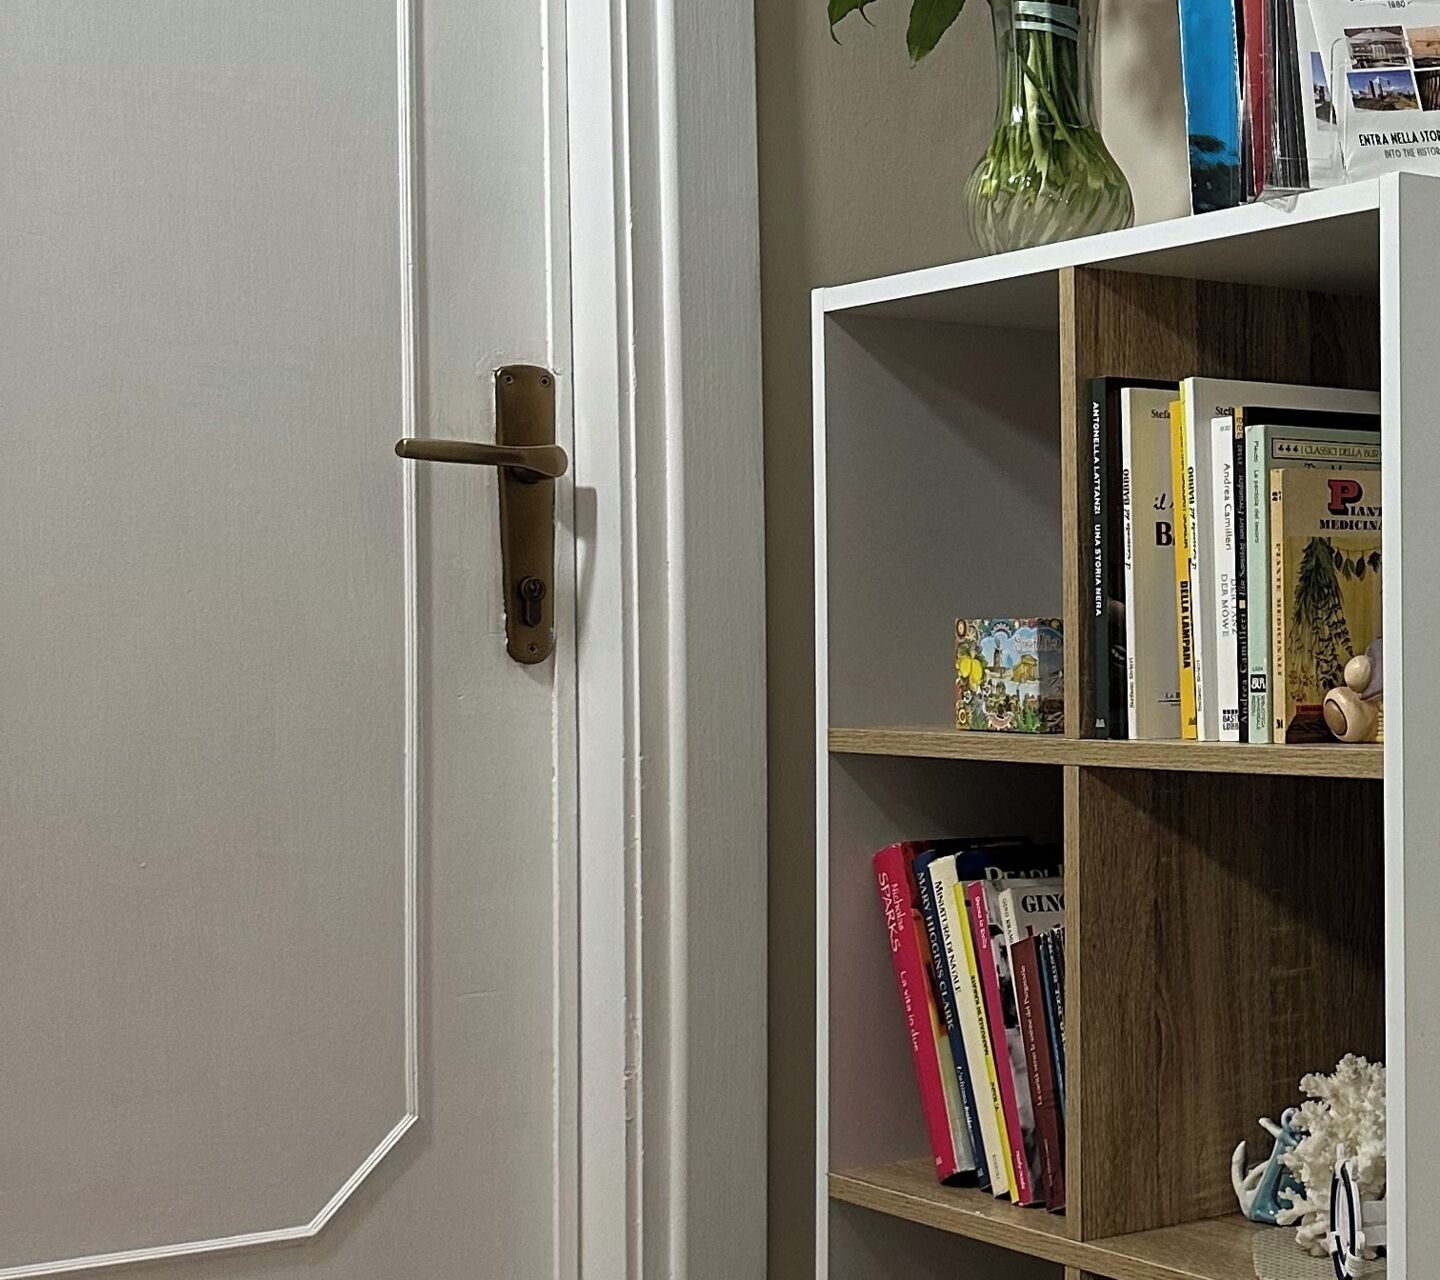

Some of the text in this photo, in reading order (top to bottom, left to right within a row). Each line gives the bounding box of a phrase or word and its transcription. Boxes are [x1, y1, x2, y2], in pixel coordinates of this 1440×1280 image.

[1359, 134, 1390, 146] ENTRA
[1391, 132, 1418, 145] NELLA
[1384, 148, 1401, 159] INTO
[1402, 147, 1416, 158] THE
[1092, 401, 1102, 515] ANTONELLA LATTANZI
[1304, 445, 1338, 456] CLASSICI
[1338, 446, 1361, 458] DELLA
[1223, 463, 1233, 551] Andrea Camilleri
[1094, 523, 1103, 617] UNA STORIA NERA
[1220, 573, 1228, 600] DER
[1180, 580, 1191, 669] DELLA LAMPARA
[1239, 609, 1248, 724] Andrea Camilleri
[878, 871, 902, 954] SPARKS
[890, 882, 905, 932] Nicholas
[934, 879, 963, 995] MINIATURA DI NATALE
[916, 871, 955, 1030] MARY HIGGINS CLARK
[900, 970, 907, 987] La
[904, 988, 912, 1012] vita
[908, 1012, 915, 1027] in
